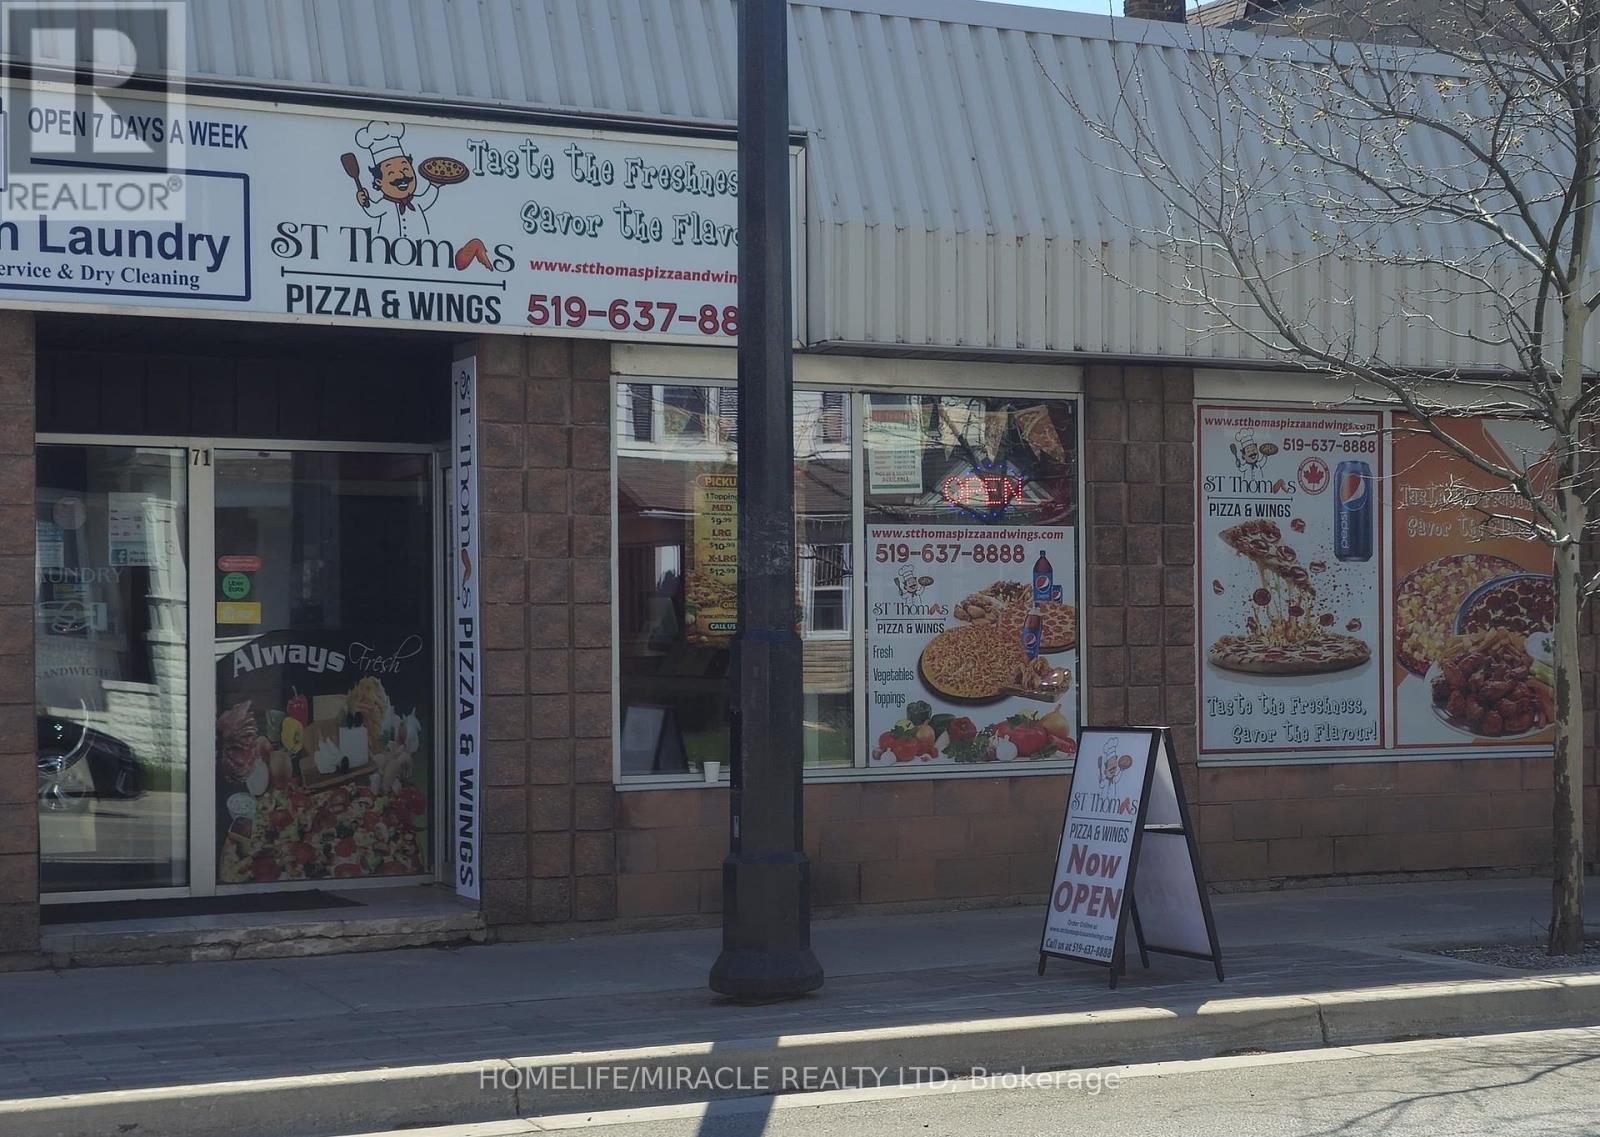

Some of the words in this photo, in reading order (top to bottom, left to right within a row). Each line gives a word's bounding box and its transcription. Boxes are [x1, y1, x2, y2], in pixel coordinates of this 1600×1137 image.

[28, 107, 86, 137] OPEN
[93, 114, 104, 138] 7
[111, 114, 164, 143] DAYS
[170, 119, 185, 144] A
[189, 120, 248, 149] WEEK
[467, 138, 554, 179] Taste
[564, 143, 614, 187] the
[623, 156, 738, 198] Freshnes
[520, 200, 604, 237] Savor
[613, 200, 663, 244] the
[39, 214, 231, 273] Laundry
[270, 221, 329, 260] ST
[0, 262, 51, 279] ervice
[57, 264, 73, 280] &
[81, 265, 115, 286] Dry
[121, 267, 200, 291] Cleaning
[529, 258, 738, 285] www.stthomaspizzaandwin
[286, 283, 372, 318] PIZZA
[381, 289, 401, 319] &
[408, 290, 502, 325] WINGS
[526, 293, 738, 336] 519-637-88
[1205, 417, 1376, 432] www.stthomaspizzaandwings.com
[192, 449, 211, 467] 71
[1283, 438, 1376, 454] 519-637-8888
[705, 476, 737, 487] PICKU
[944, 476, 1024, 505] OPEN
[1203, 475, 1226, 493] ST
[710, 492, 737, 501] Toppin
[1209, 503, 1241, 517] PIZZA
[1244, 504, 1252, 517] &
[1255, 503, 1291, 518] WINGS
[712, 529, 732, 537] LRG
[872, 528, 1064, 541] www.stthomaspizzaandwings.com
[1340, 511, 1350, 549] pepsi
[875, 543, 1025, 563] 519-637-8888
[877, 623, 904, 634] PIZZA
[907, 623, 912, 634] &
[914, 623, 945, 634] WINGS
[233, 642, 346, 679] Always
[348, 634, 423, 675] Fresh
[873, 645, 894, 659] Fresh
[458, 617, 475, 721] PIZZA
[873, 667, 915, 686] Vegetables
[874, 690, 906, 708] Toppings
[1207, 692, 1253, 717] Taste
[1257, 692, 1286, 716] the
[1290, 695, 1368, 716] Freshness,
[459, 733, 474, 756] &
[1232, 724, 1278, 745] Savor
[1282, 720, 1310, 743] the
[1314, 720, 1378, 743] Flavour!
[458, 768, 475, 888] WINGS
[1070, 823, 1092, 841] PIZZA
[1094, 826, 1100, 841] &
[1101, 825, 1130, 843] WINGS
[1053, 880, 1123, 920] OPEN
[1045, 937, 1058, 949] Call
[1065, 942, 1073, 952] at
